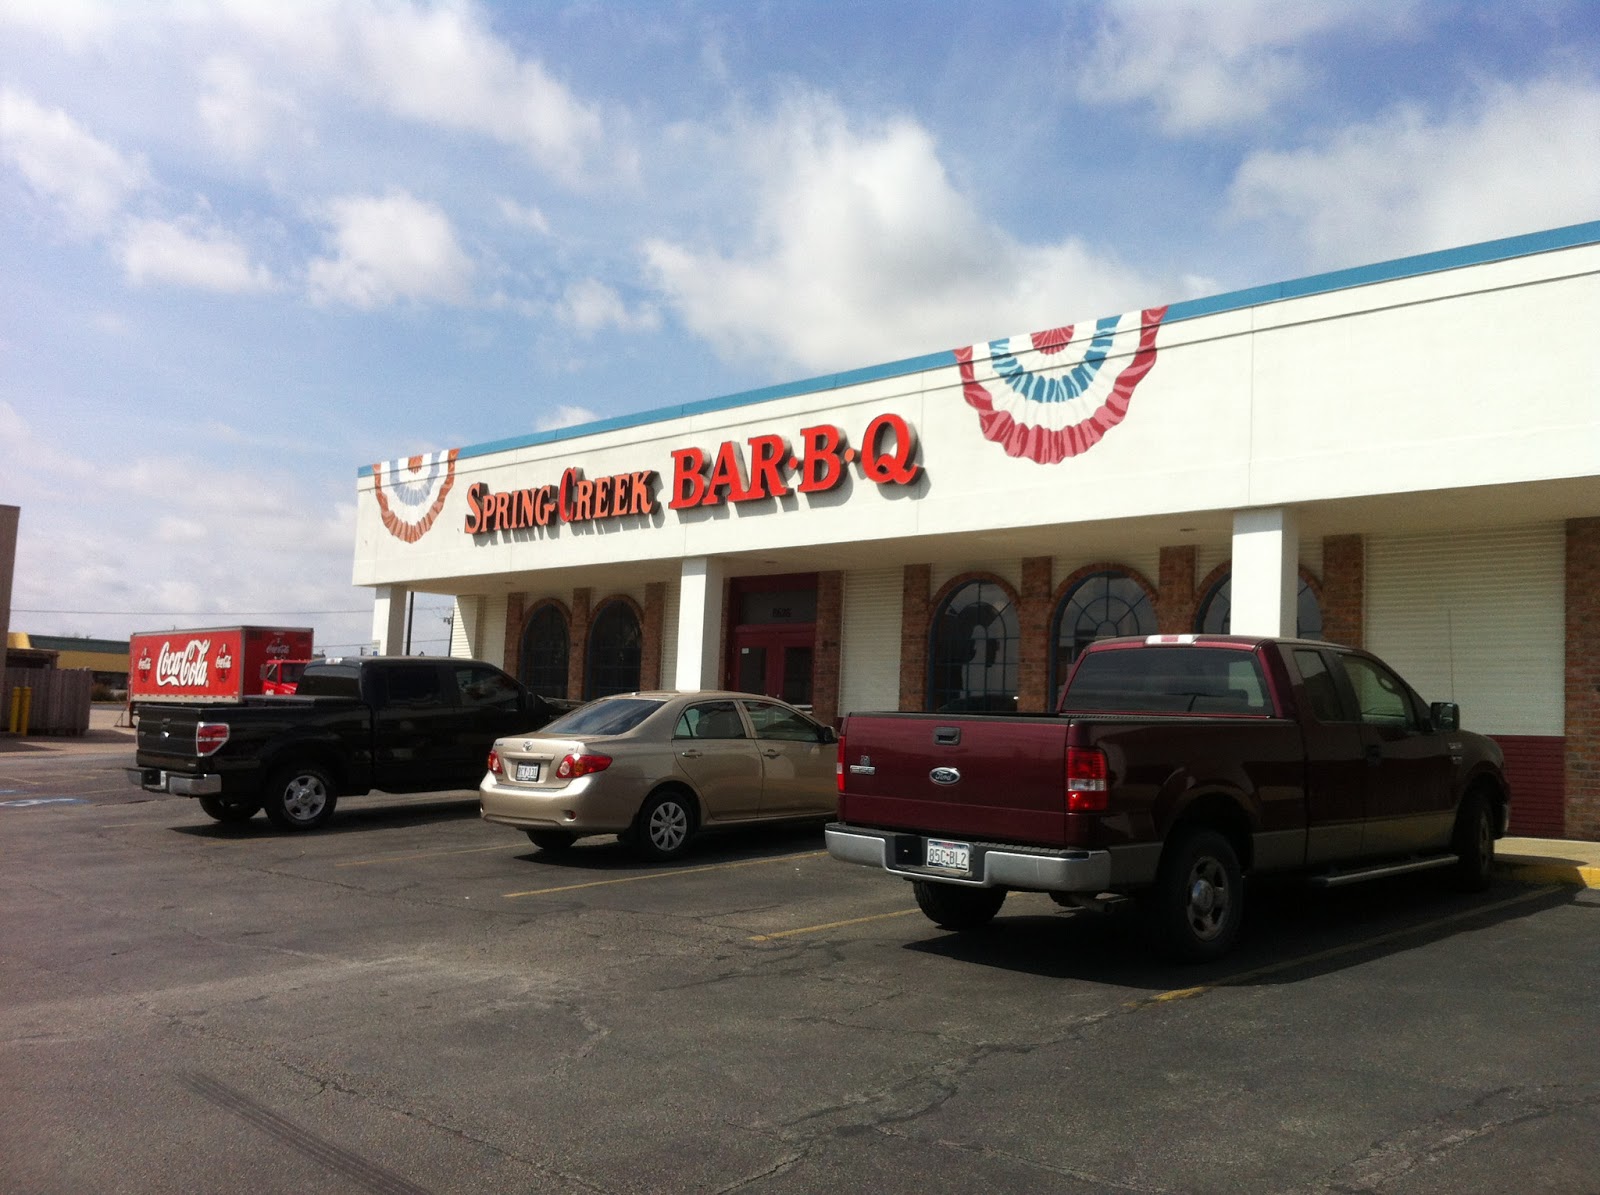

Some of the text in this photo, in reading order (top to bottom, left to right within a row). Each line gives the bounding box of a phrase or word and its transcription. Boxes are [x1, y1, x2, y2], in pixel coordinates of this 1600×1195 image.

[464, 482, 556, 534] SPRING
[558, 466, 653, 523] CREEK
[156, 639, 211, 687] Coca-Cola
